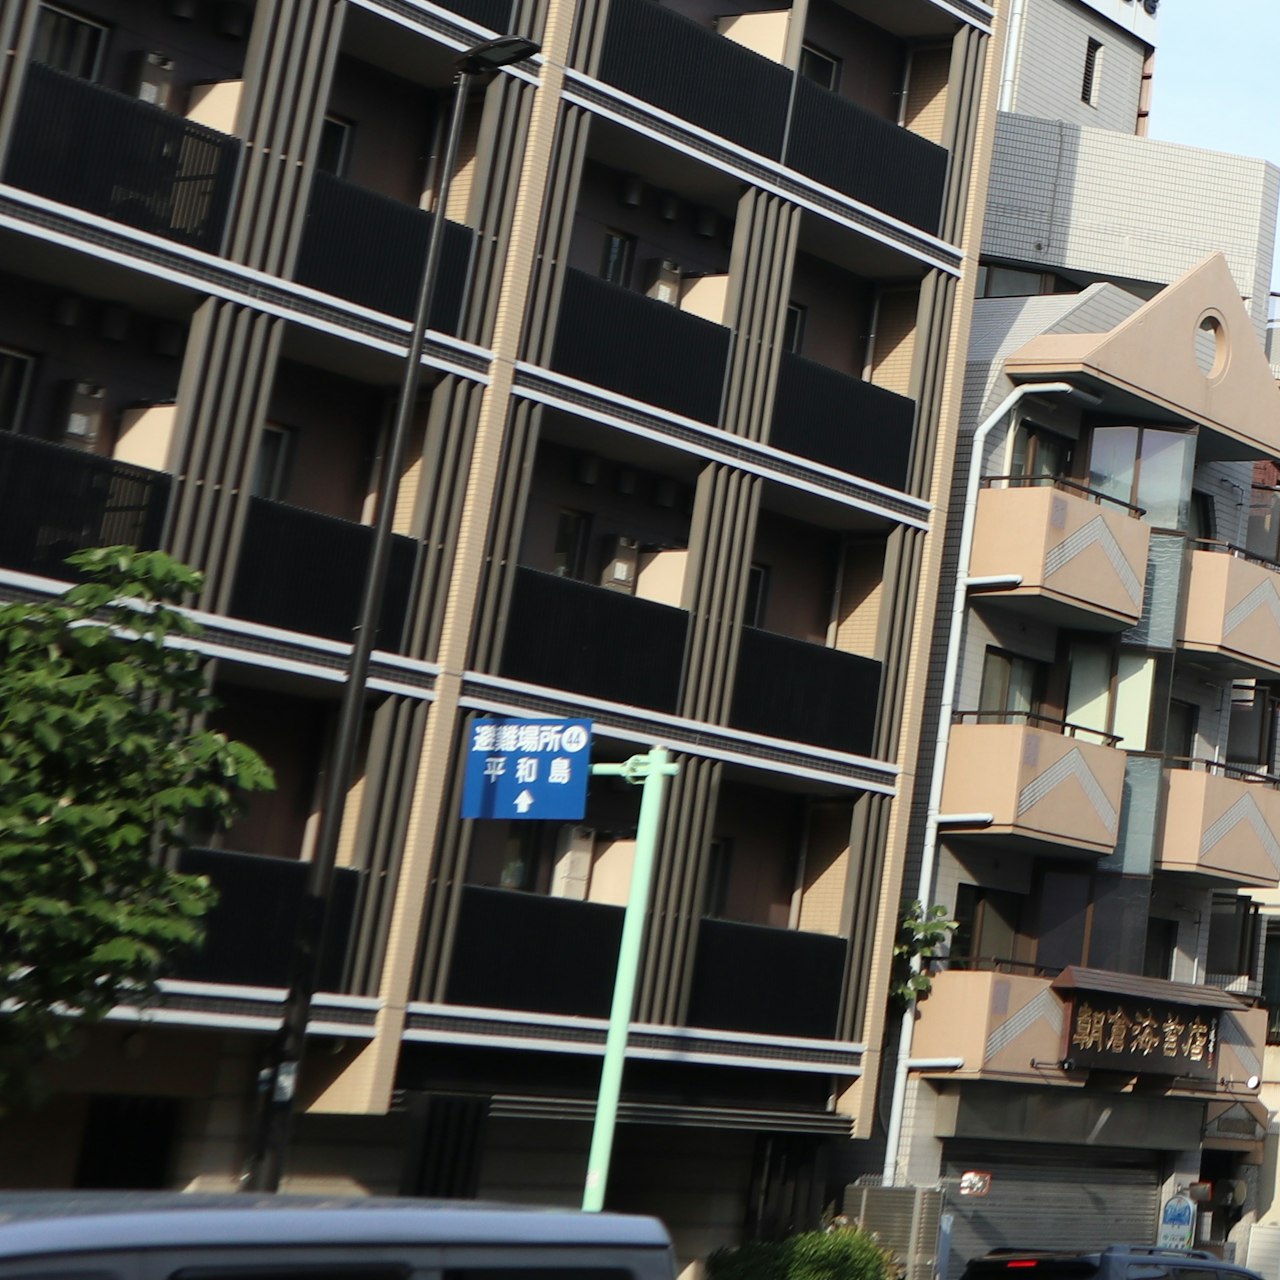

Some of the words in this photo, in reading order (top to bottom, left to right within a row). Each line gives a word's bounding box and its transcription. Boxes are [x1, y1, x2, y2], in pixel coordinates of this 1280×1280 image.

[471, 724, 564, 753] 避難場所
[483, 756, 573, 785] 平和島
